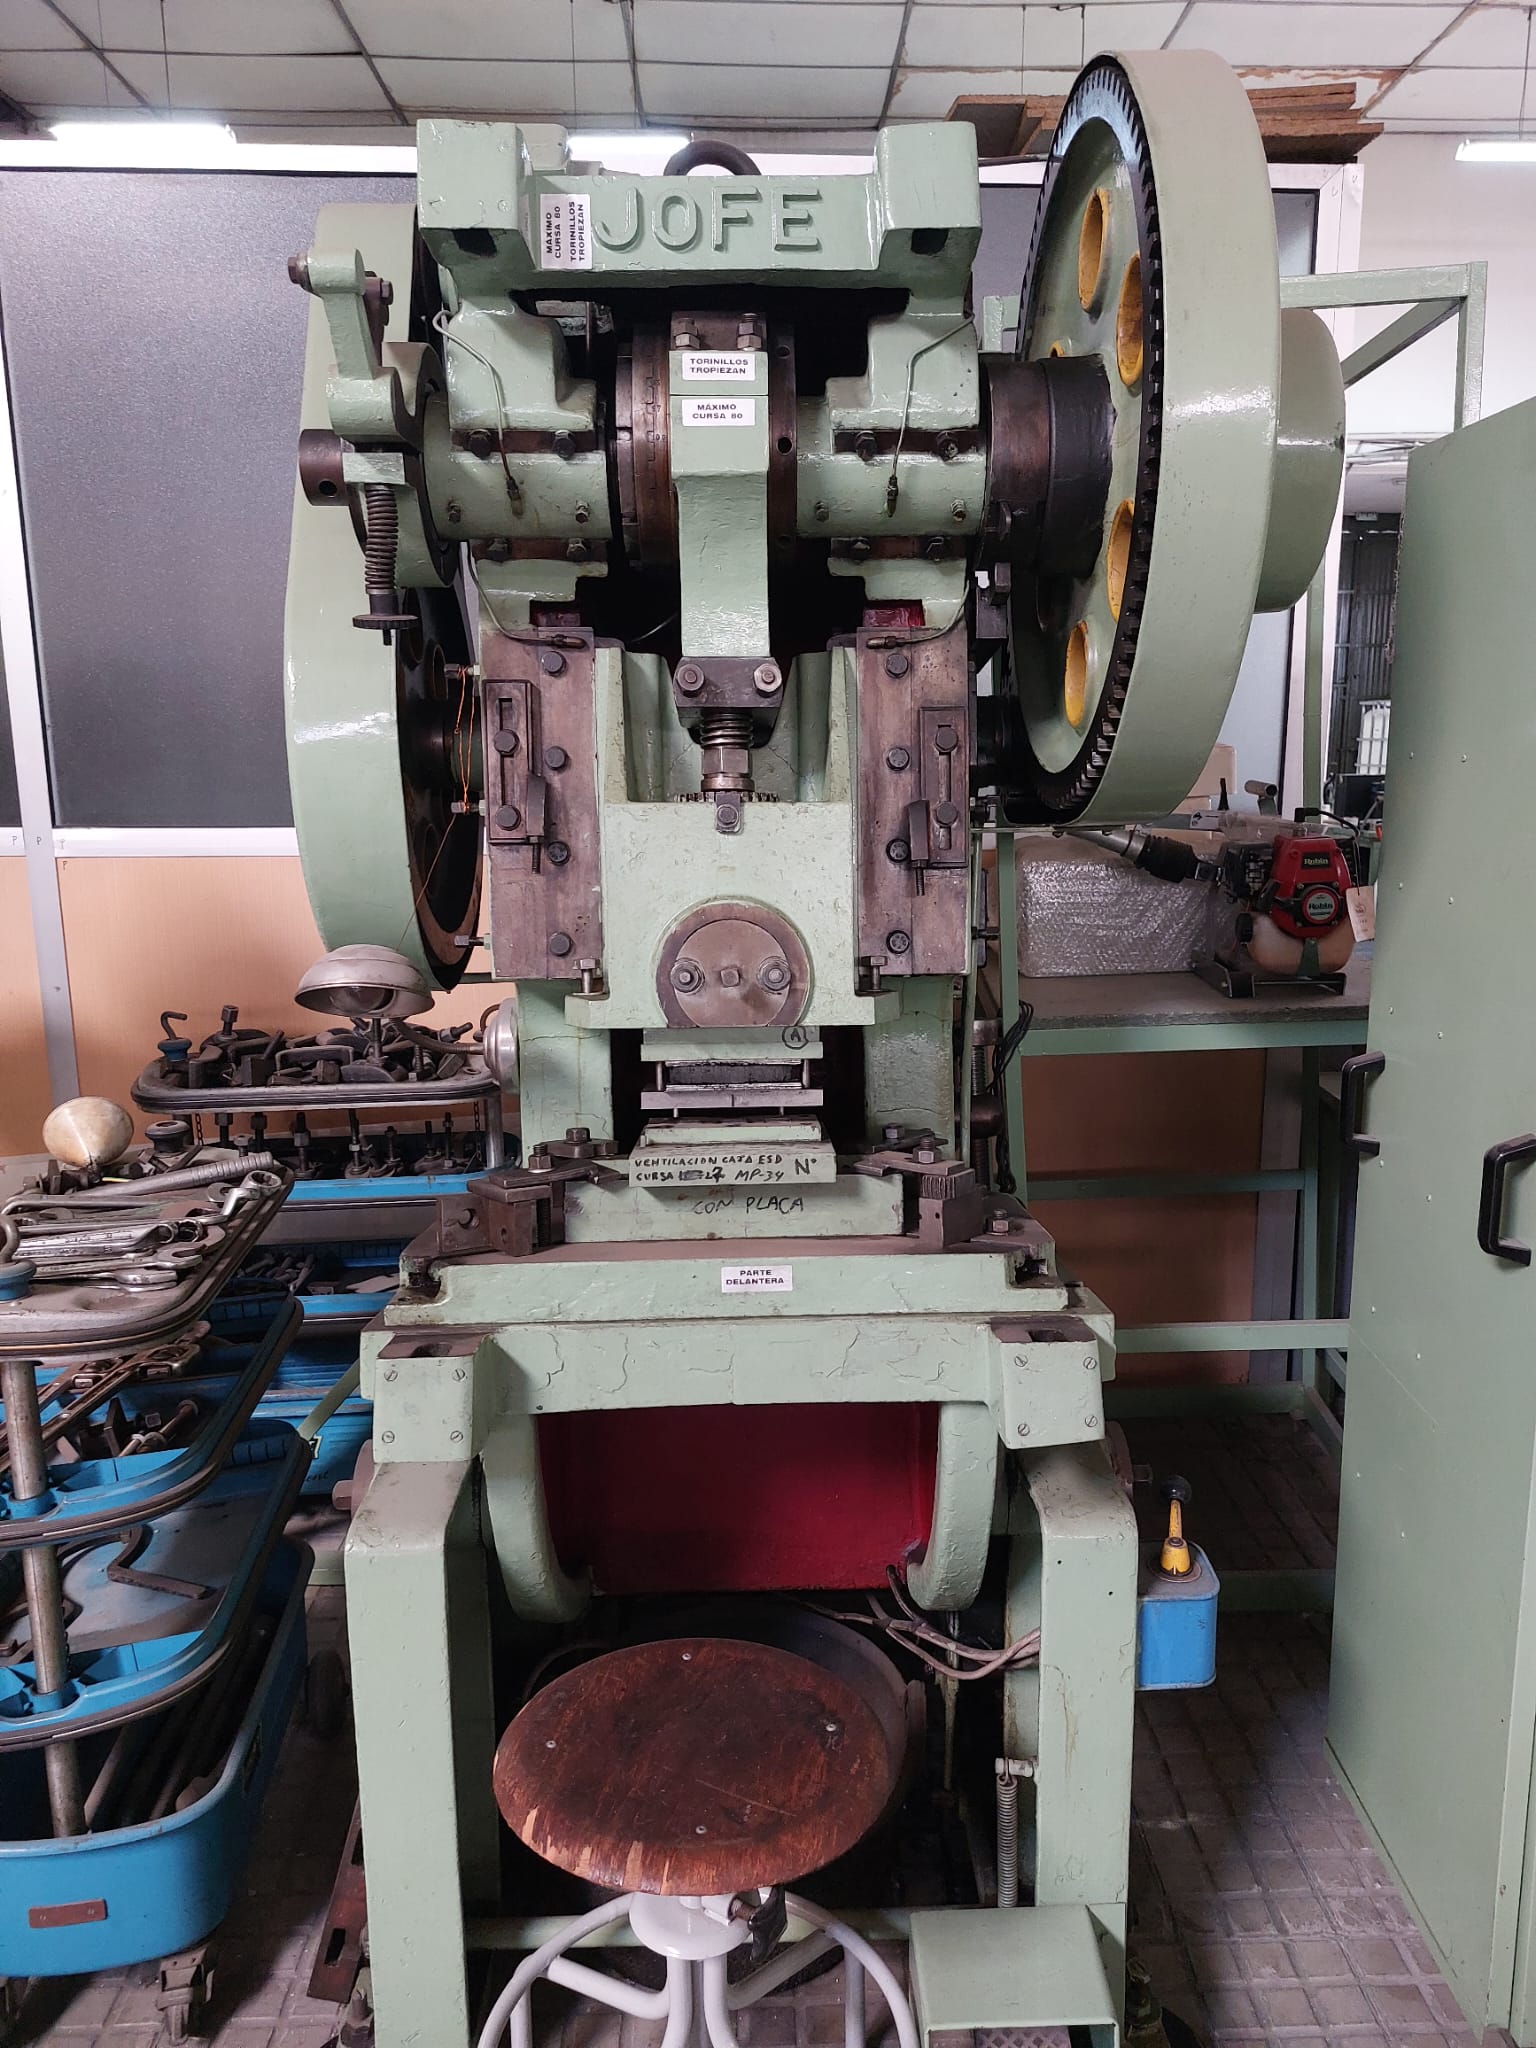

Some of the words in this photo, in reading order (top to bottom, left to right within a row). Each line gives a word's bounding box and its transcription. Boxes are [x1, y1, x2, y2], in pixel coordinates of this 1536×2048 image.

[592, 185, 823, 252] JOFE
[690, 367, 746, 375] TROPIEZAN
[635, 1157, 718, 1167] VENTILACION
[758, 1154, 783, 1165] ESD
[636, 1172, 674, 1181] CURSA
[693, 1199, 734, 1215] CON
[746, 1196, 804, 1214] PLACA
